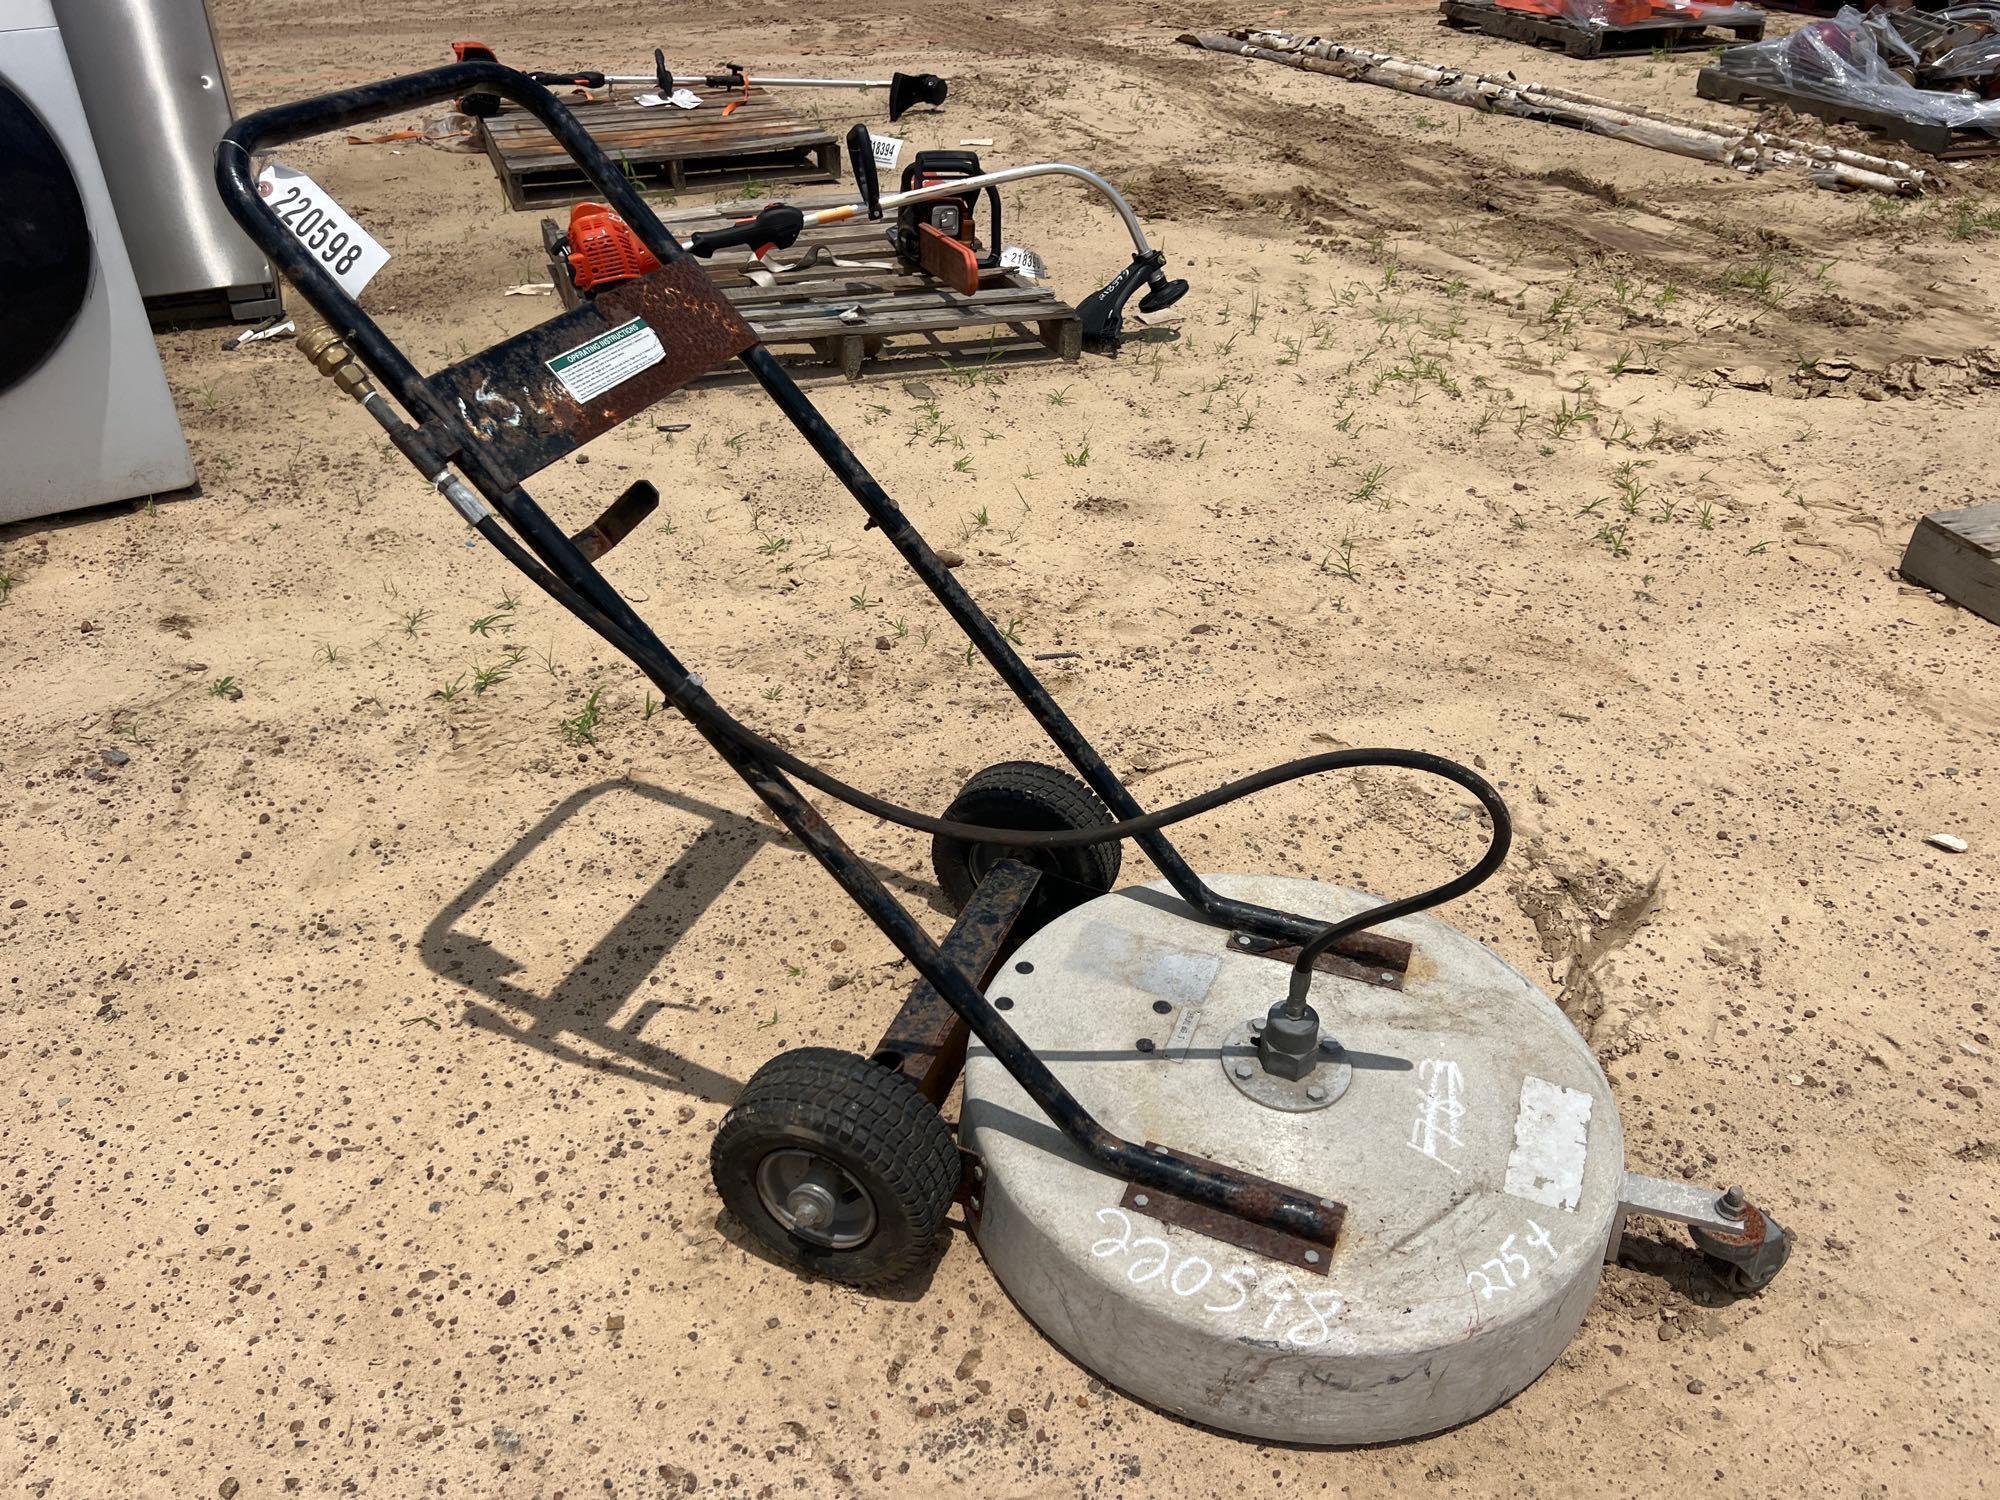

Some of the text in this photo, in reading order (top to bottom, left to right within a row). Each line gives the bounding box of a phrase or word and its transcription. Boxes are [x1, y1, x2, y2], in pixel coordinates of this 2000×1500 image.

[871, 141, 896, 157] 18394
[270, 187, 363, 275] 220598
[567, 324, 639, 363] OPERATING INSTRUCTIONS
[1092, 1207, 1345, 1346] 220598
